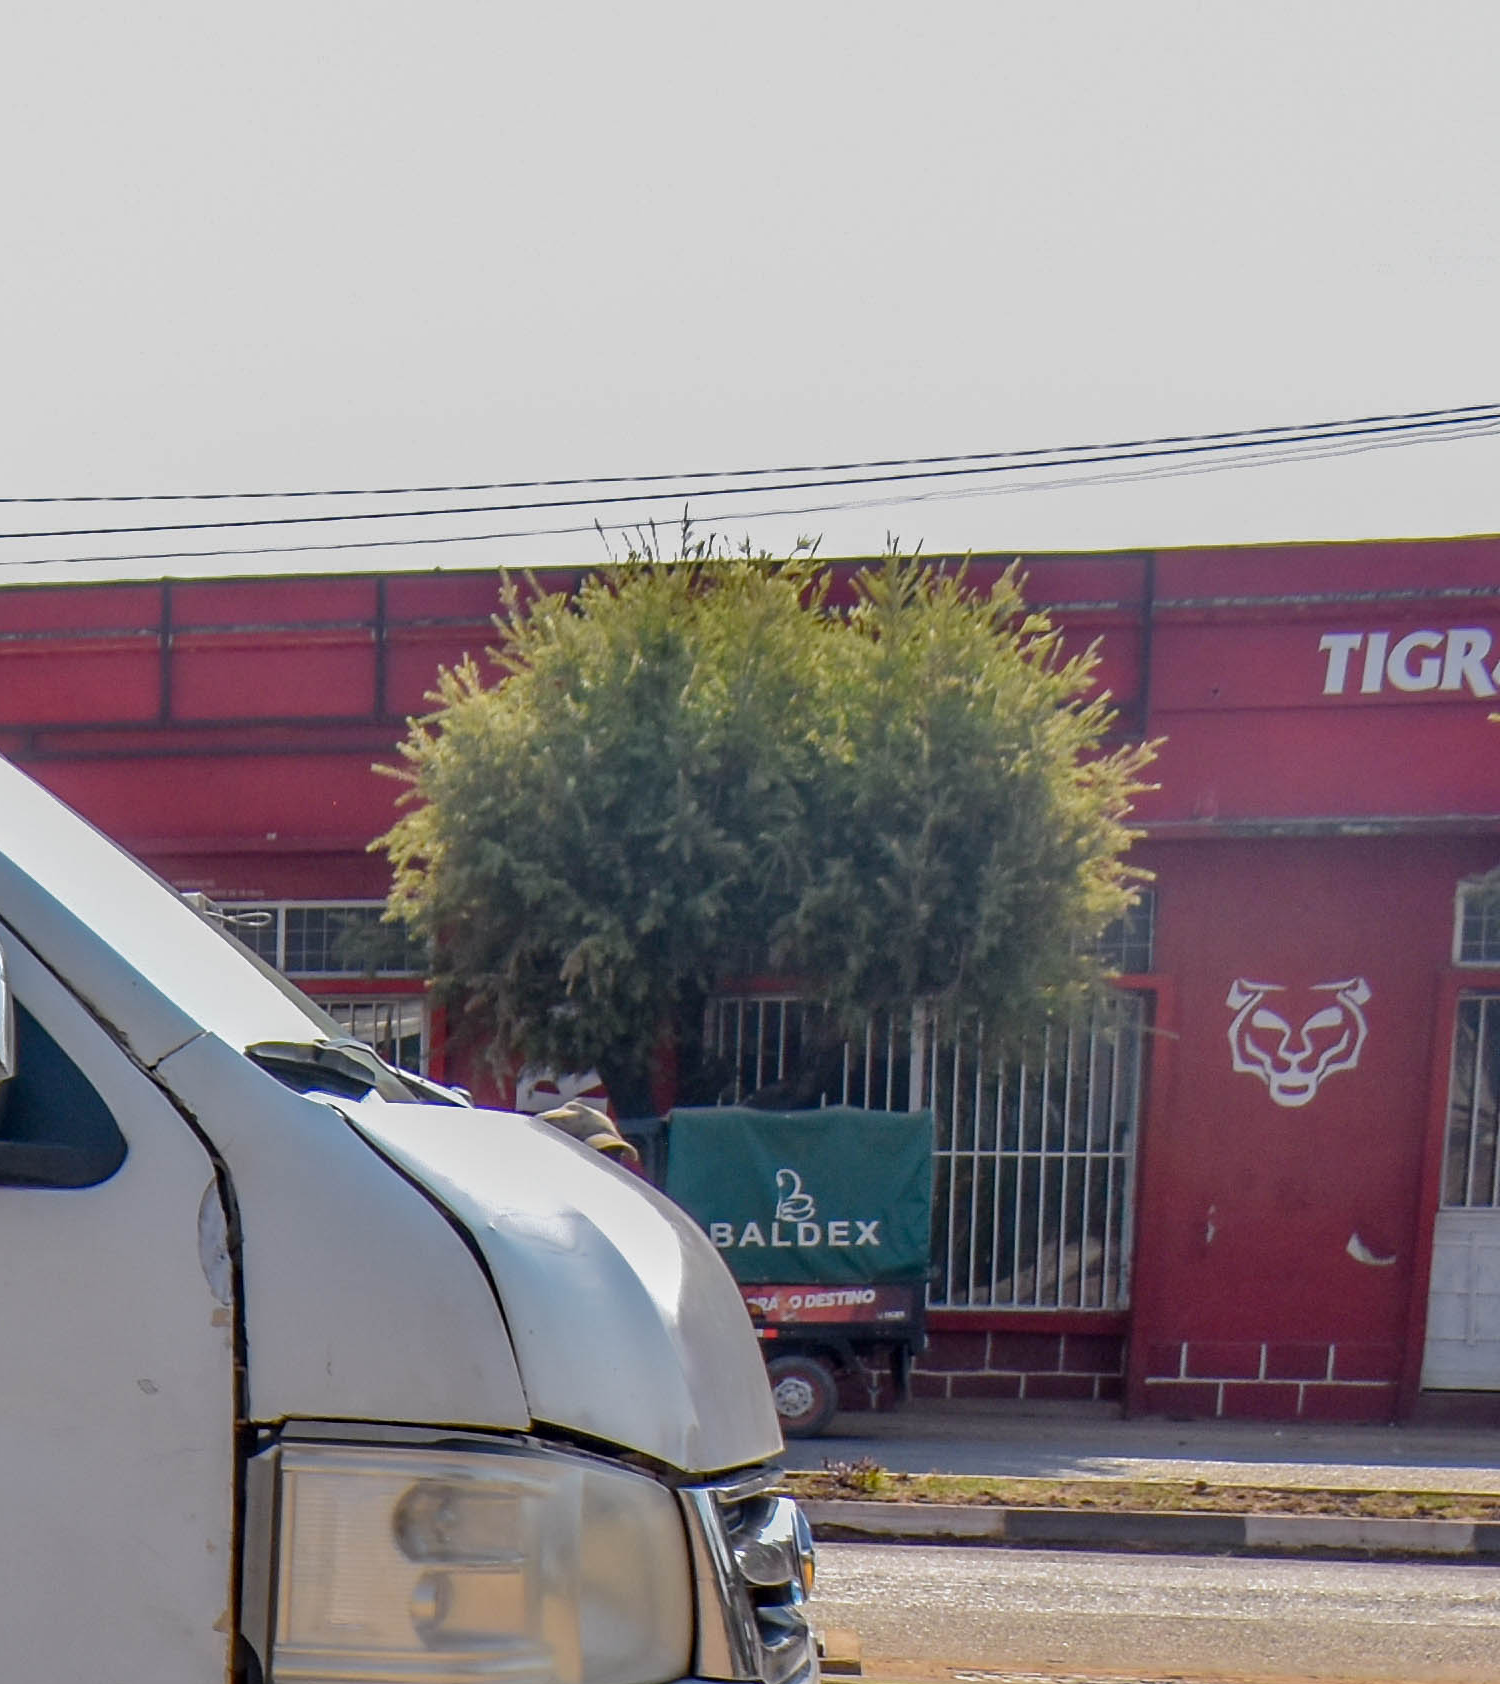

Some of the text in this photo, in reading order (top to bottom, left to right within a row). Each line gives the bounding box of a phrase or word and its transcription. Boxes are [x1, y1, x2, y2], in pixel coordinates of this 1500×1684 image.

[1318, 627, 1500, 698] TIGR
[710, 1220, 881, 1247] BALDEX
[804, 1289, 876, 1309] DESTINO
